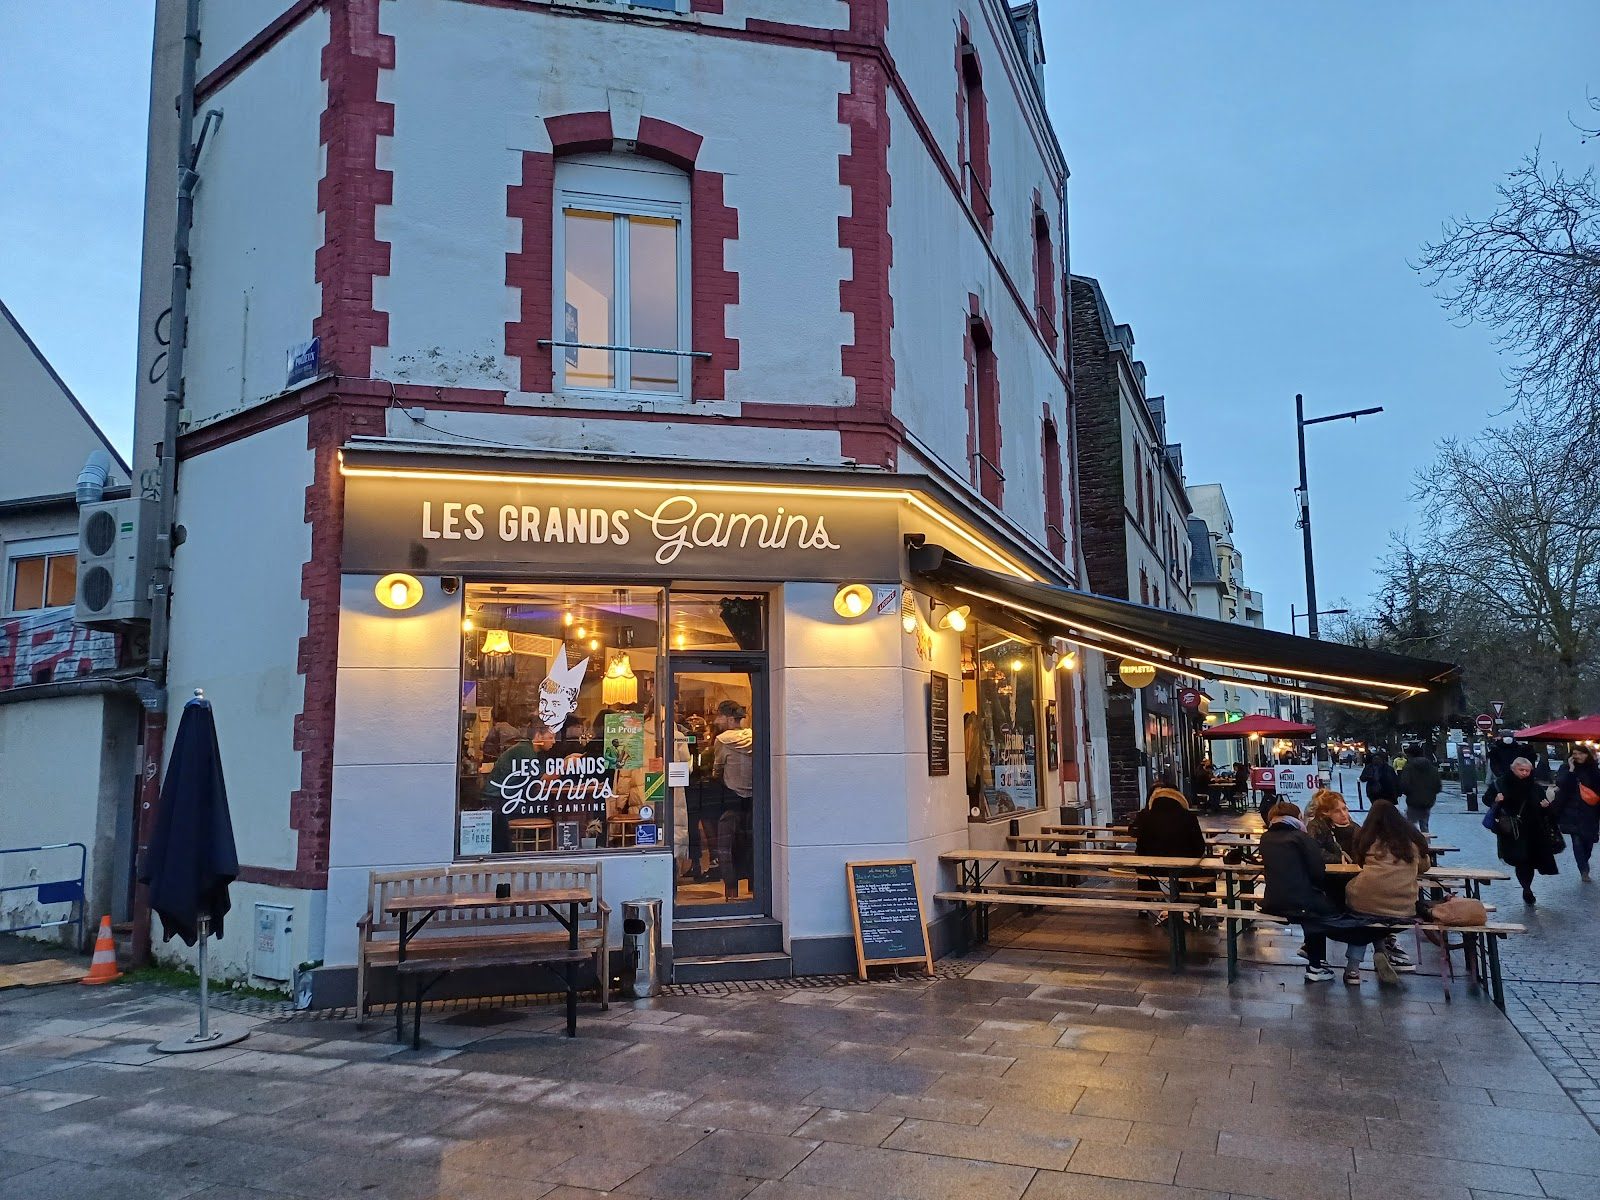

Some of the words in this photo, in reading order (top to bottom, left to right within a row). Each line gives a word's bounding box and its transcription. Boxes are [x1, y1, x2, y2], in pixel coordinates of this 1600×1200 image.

[422, 500, 485, 540] LES
[499, 504, 630, 546] GRANDS
[633, 495, 841, 566] Gamins
[1119, 665, 1156, 674] TRIPLETTA
[606, 726, 617, 734] La
[511, 758, 540, 777] LES
[545, 756, 606, 776] GRANDS
[1279, 773, 1295, 781] MENU
[489, 770, 620, 815] Gamins
